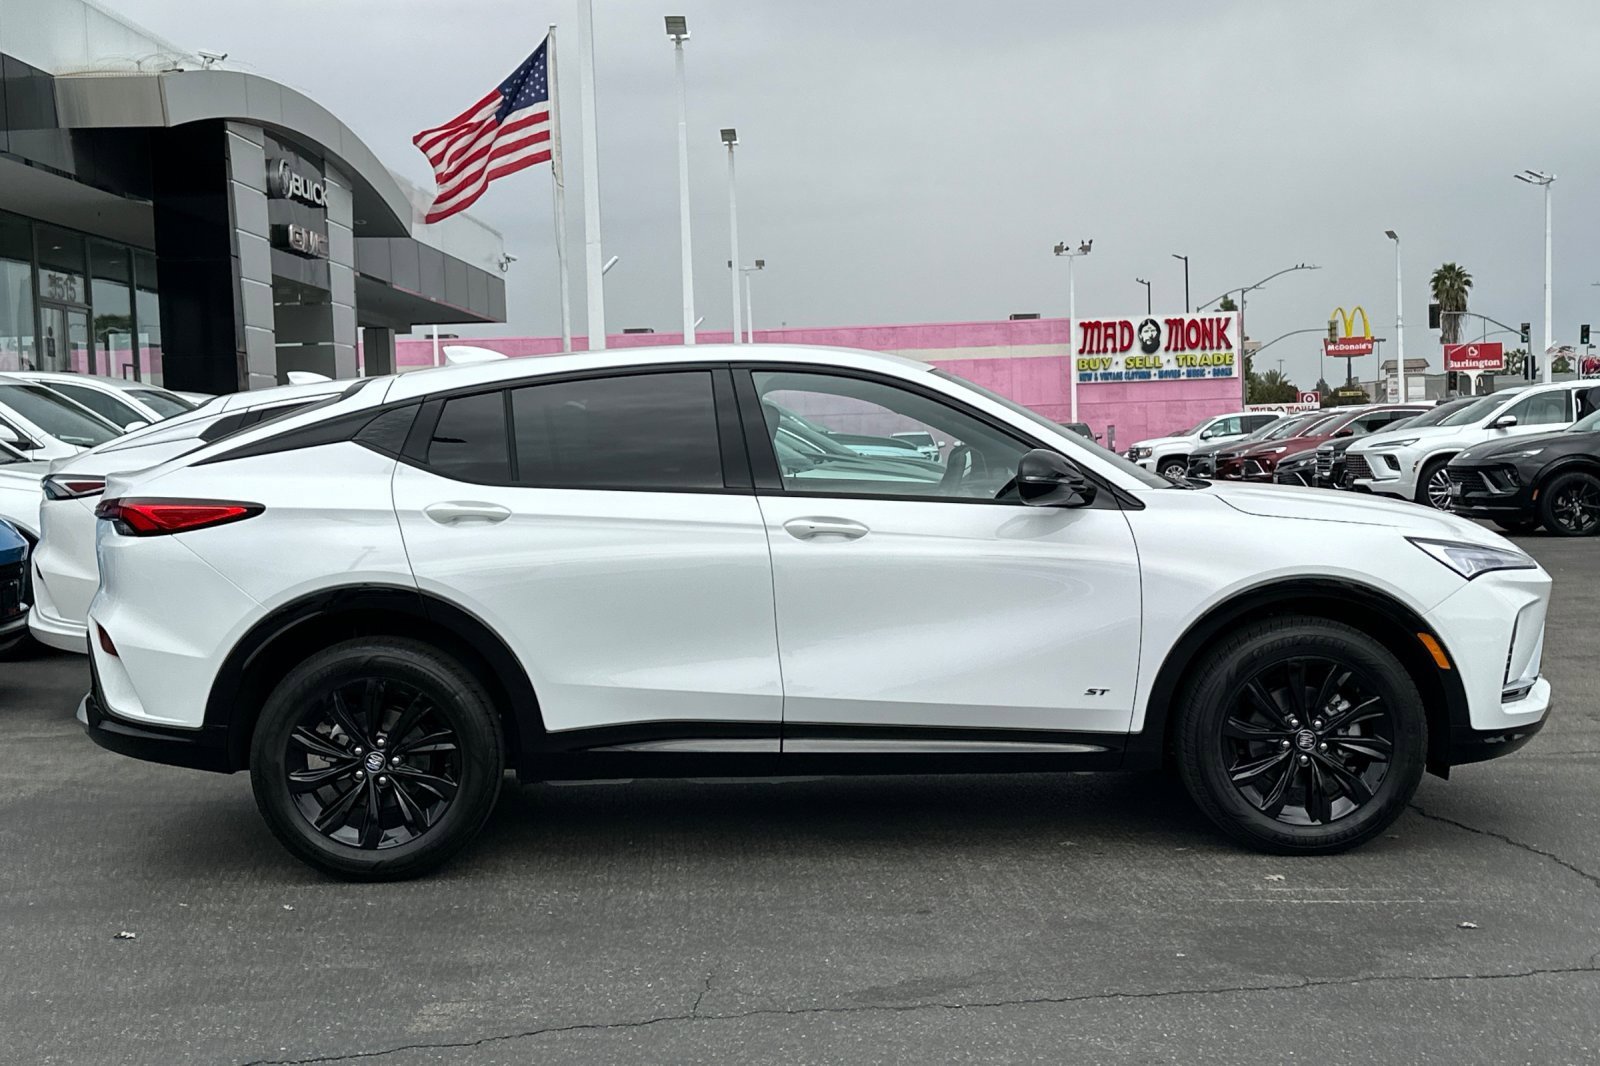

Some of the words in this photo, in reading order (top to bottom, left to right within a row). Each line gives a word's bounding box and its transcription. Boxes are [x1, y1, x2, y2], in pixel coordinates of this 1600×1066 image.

[292, 172, 328, 207] BUICK
[288, 224, 329, 259] GMC
[1078, 320, 1134, 355] MAD
[1164, 317, 1233, 352] MONK
[1327, 343, 1372, 351] McDonald's
[1077, 357, 1112, 371] BUY
[1124, 355, 1163, 369] SELL
[1176, 353, 1234, 367] TRADE
[1449, 359, 1501, 369] Burlington
[1079, 372, 1092, 382] NEW
[1099, 371, 1123, 381] VINTAGE
[1124, 370, 1151, 381] CLOTHING
[1158, 369, 1181, 379] MOVIES
[1186, 368, 1206, 378] MUSIC
[1212, 367, 1233, 377] BOOKS
[1084, 688, 1110, 696] ST
